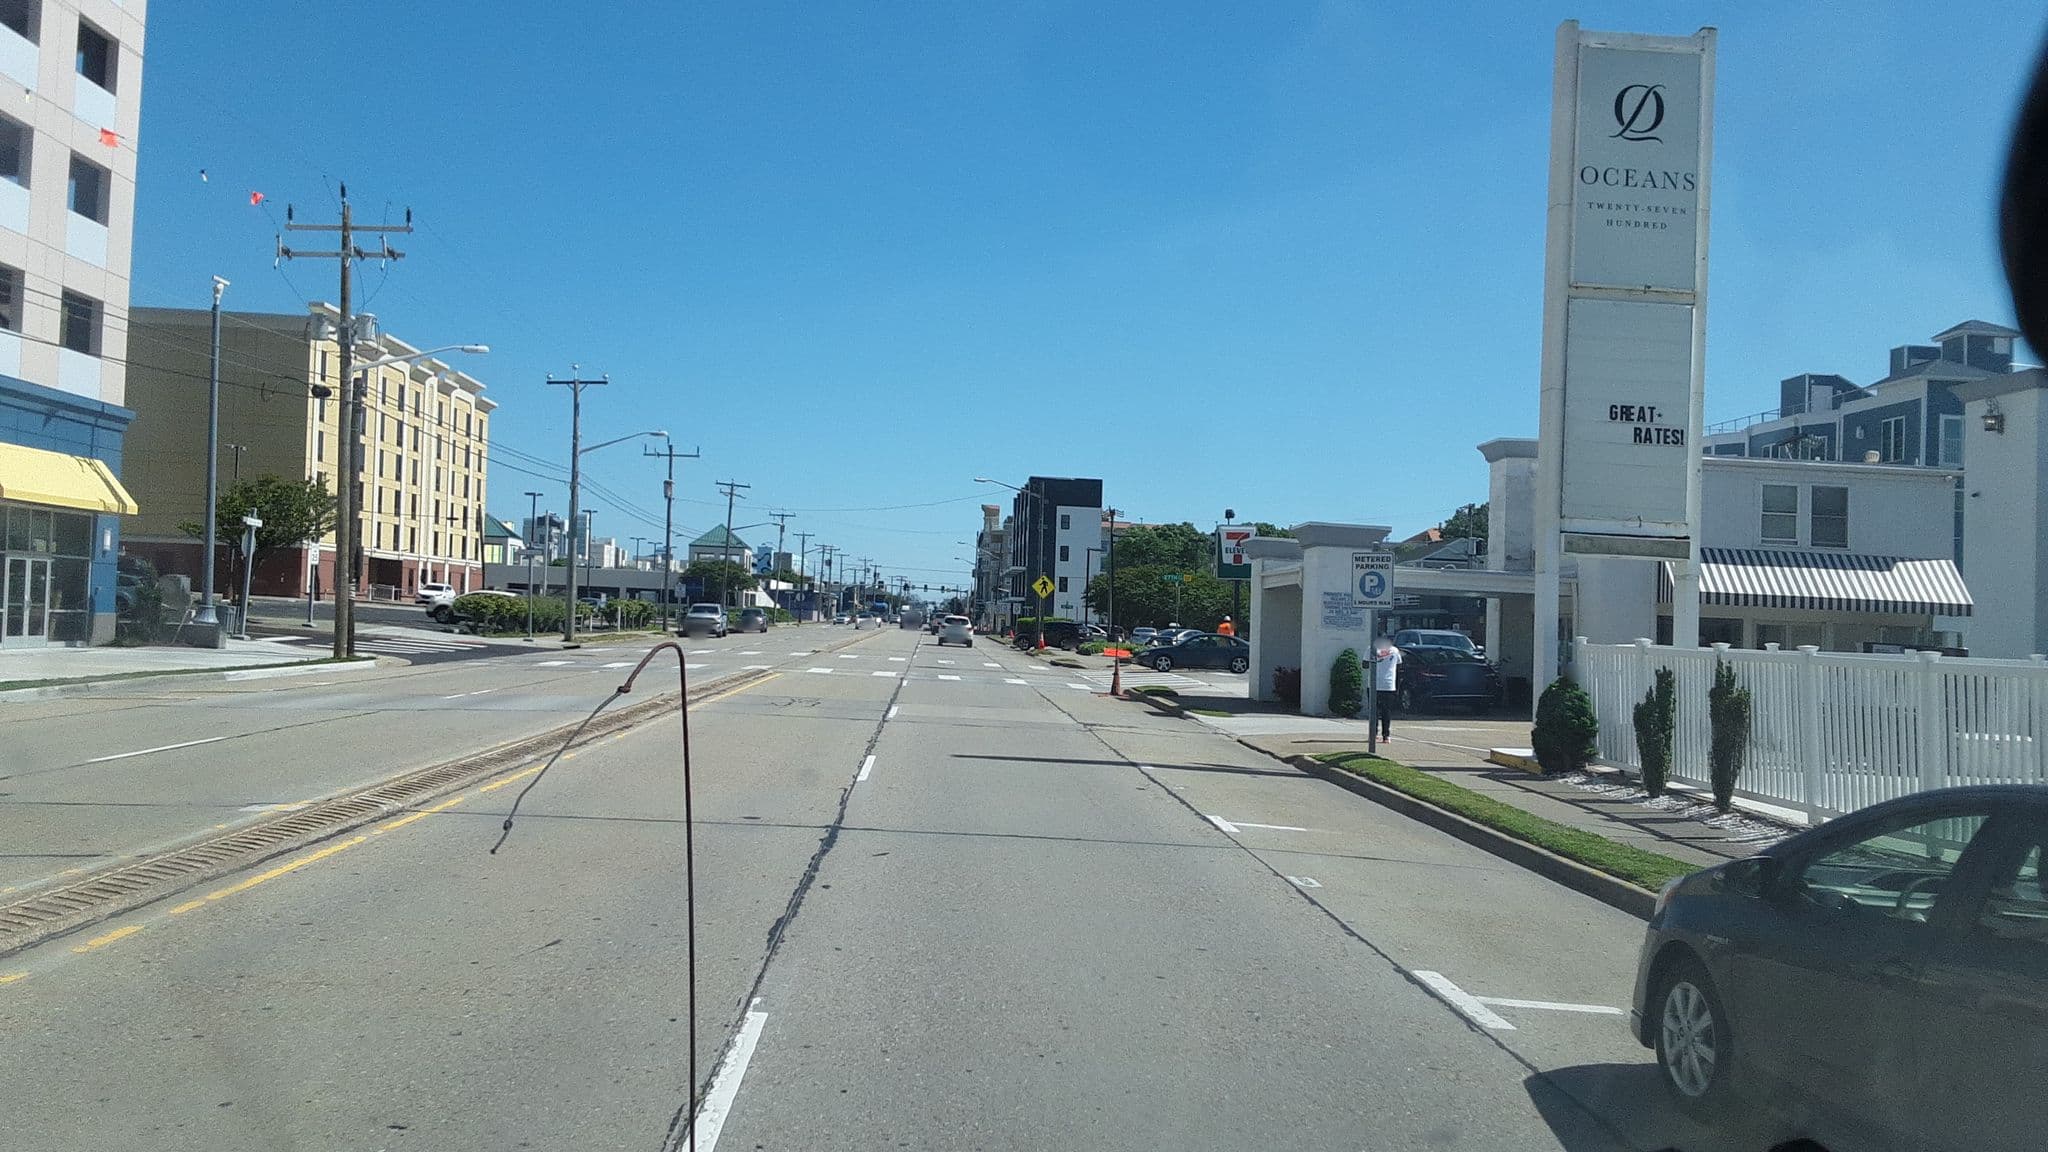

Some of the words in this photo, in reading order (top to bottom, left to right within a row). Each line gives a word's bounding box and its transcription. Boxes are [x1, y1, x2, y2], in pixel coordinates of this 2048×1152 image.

[1580, 165, 1696, 192] OCEANS
[1588, 201, 1687, 215] TWENTY-SEVEN
[1606, 219, 1668, 230] HUNDRED
[1633, 427, 1685, 446] RATES!
[1225, 546, 1248, 554] ELEVE
